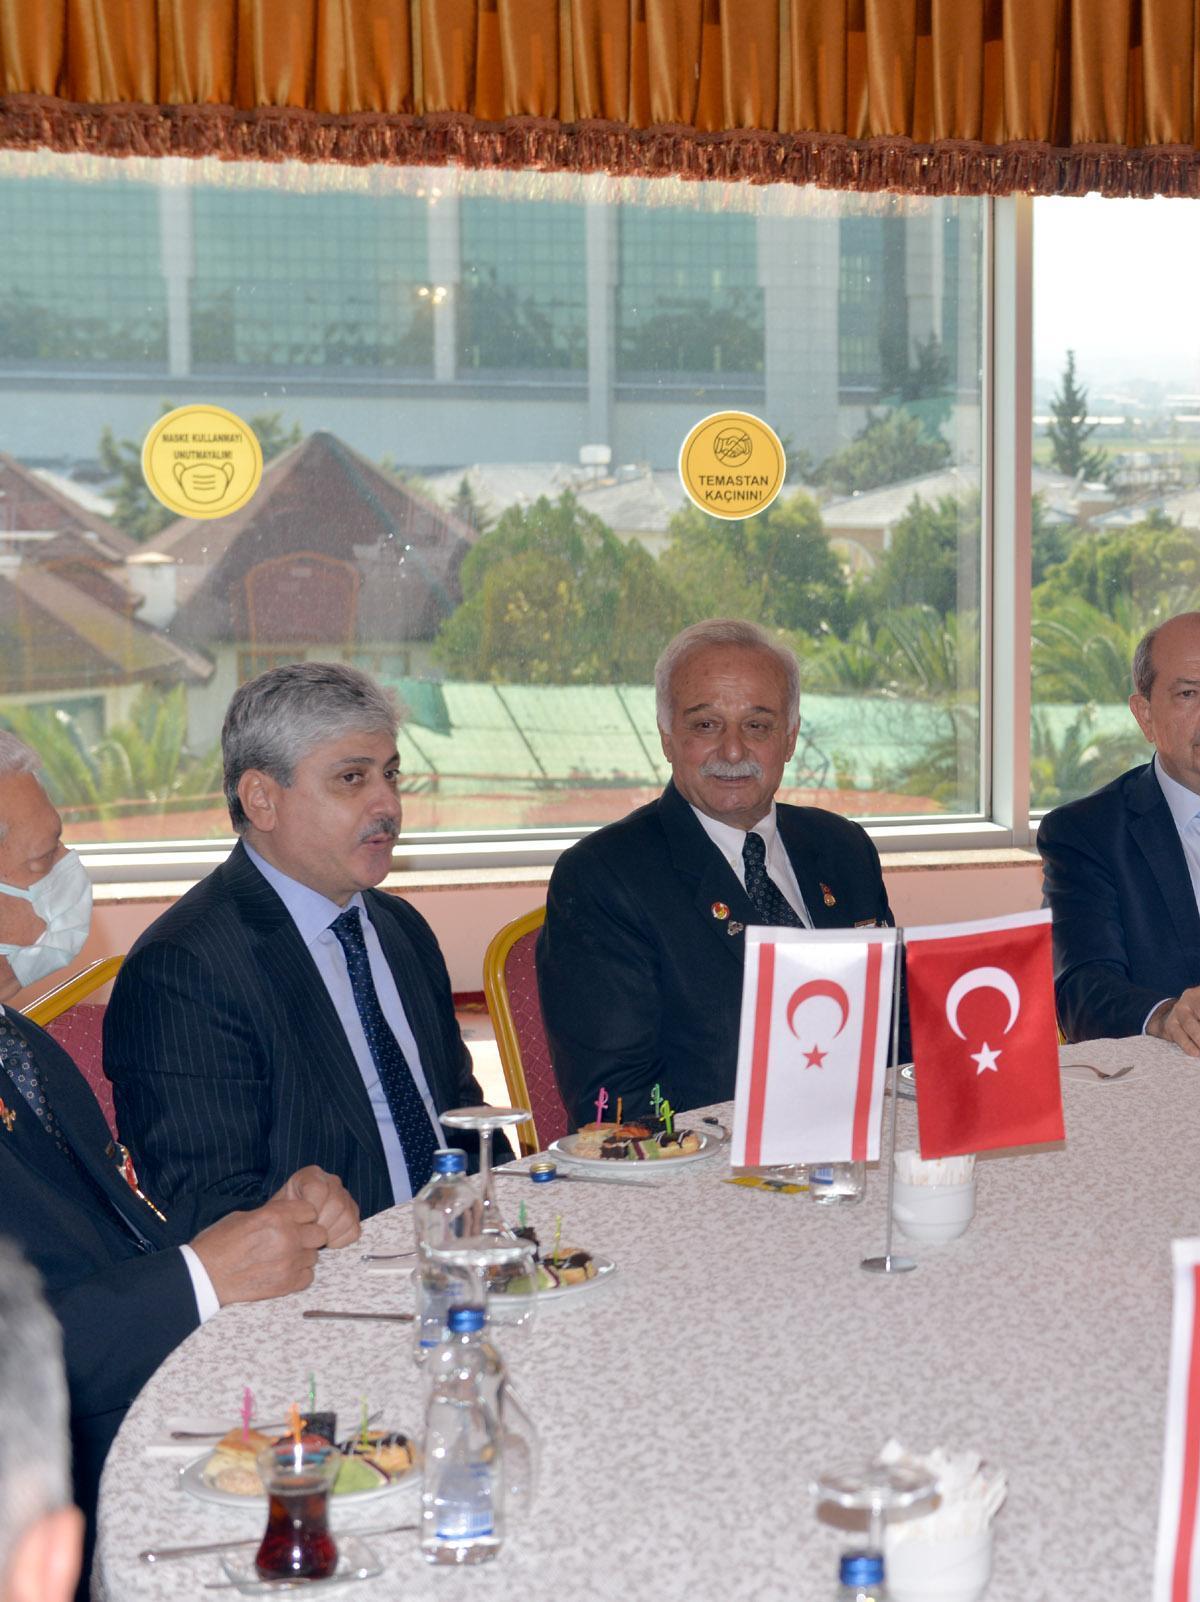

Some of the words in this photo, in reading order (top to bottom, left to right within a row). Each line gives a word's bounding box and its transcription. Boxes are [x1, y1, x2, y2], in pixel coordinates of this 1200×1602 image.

[162, 433, 188, 442] MASKE
[192, 433, 242, 442] KULLANMAYI
[698, 475, 769, 486] TEMASTAN
[705, 490, 762, 503] KAÇININ!
